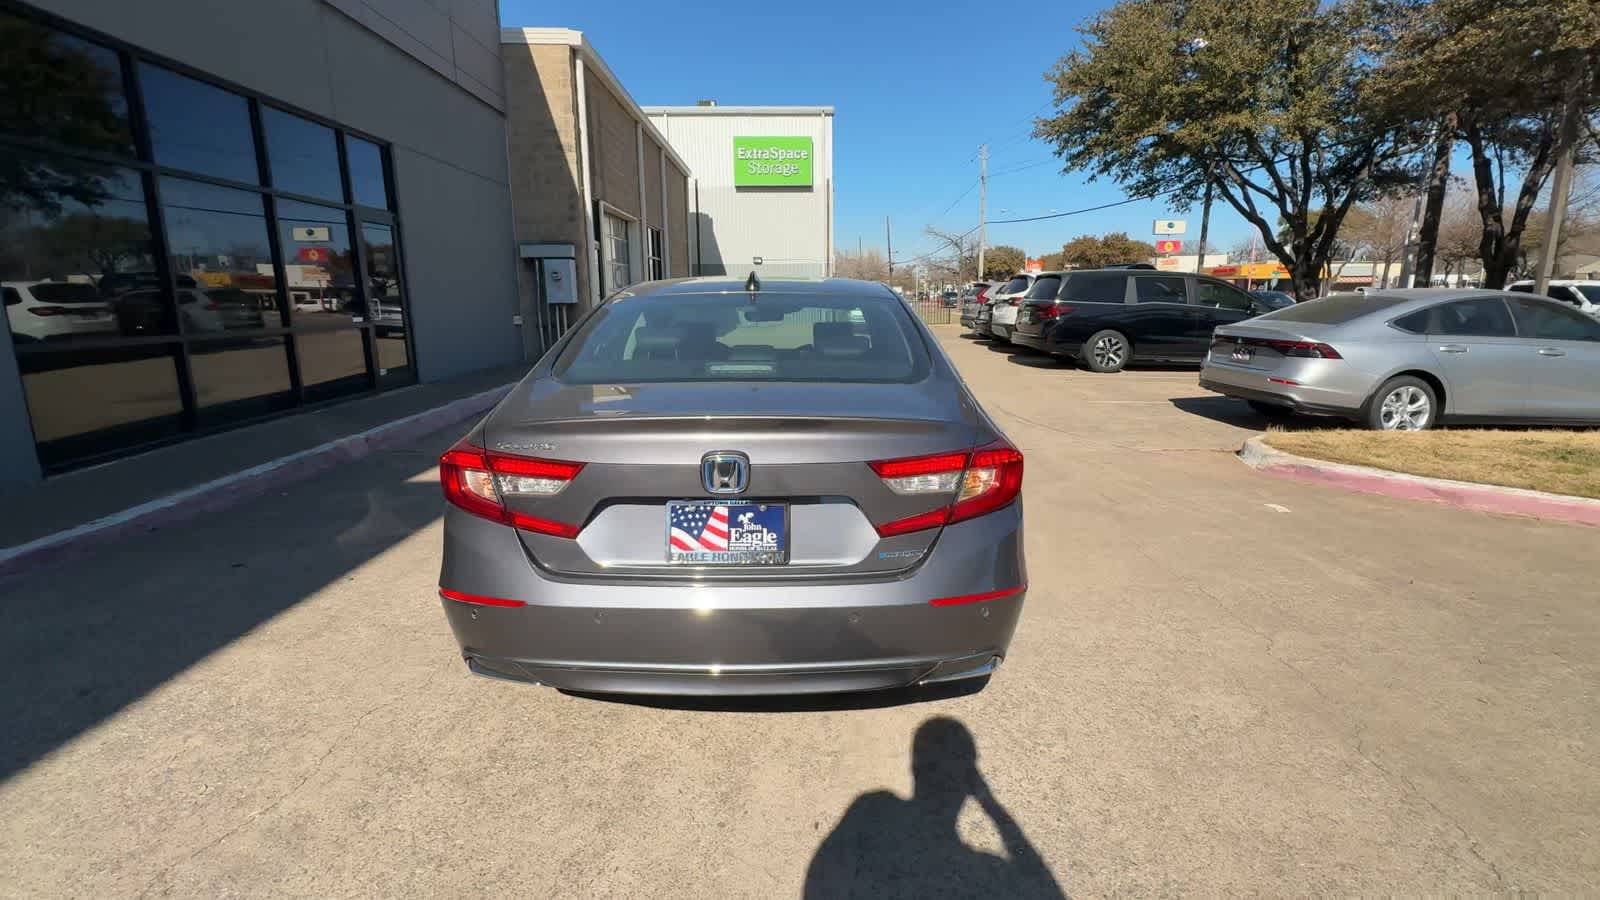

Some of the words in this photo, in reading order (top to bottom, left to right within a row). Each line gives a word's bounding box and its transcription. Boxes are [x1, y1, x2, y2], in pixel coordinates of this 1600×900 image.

[748, 160, 800, 177] Storage
[743, 522, 762, 531] John
[729, 528, 777, 547] Eagle
